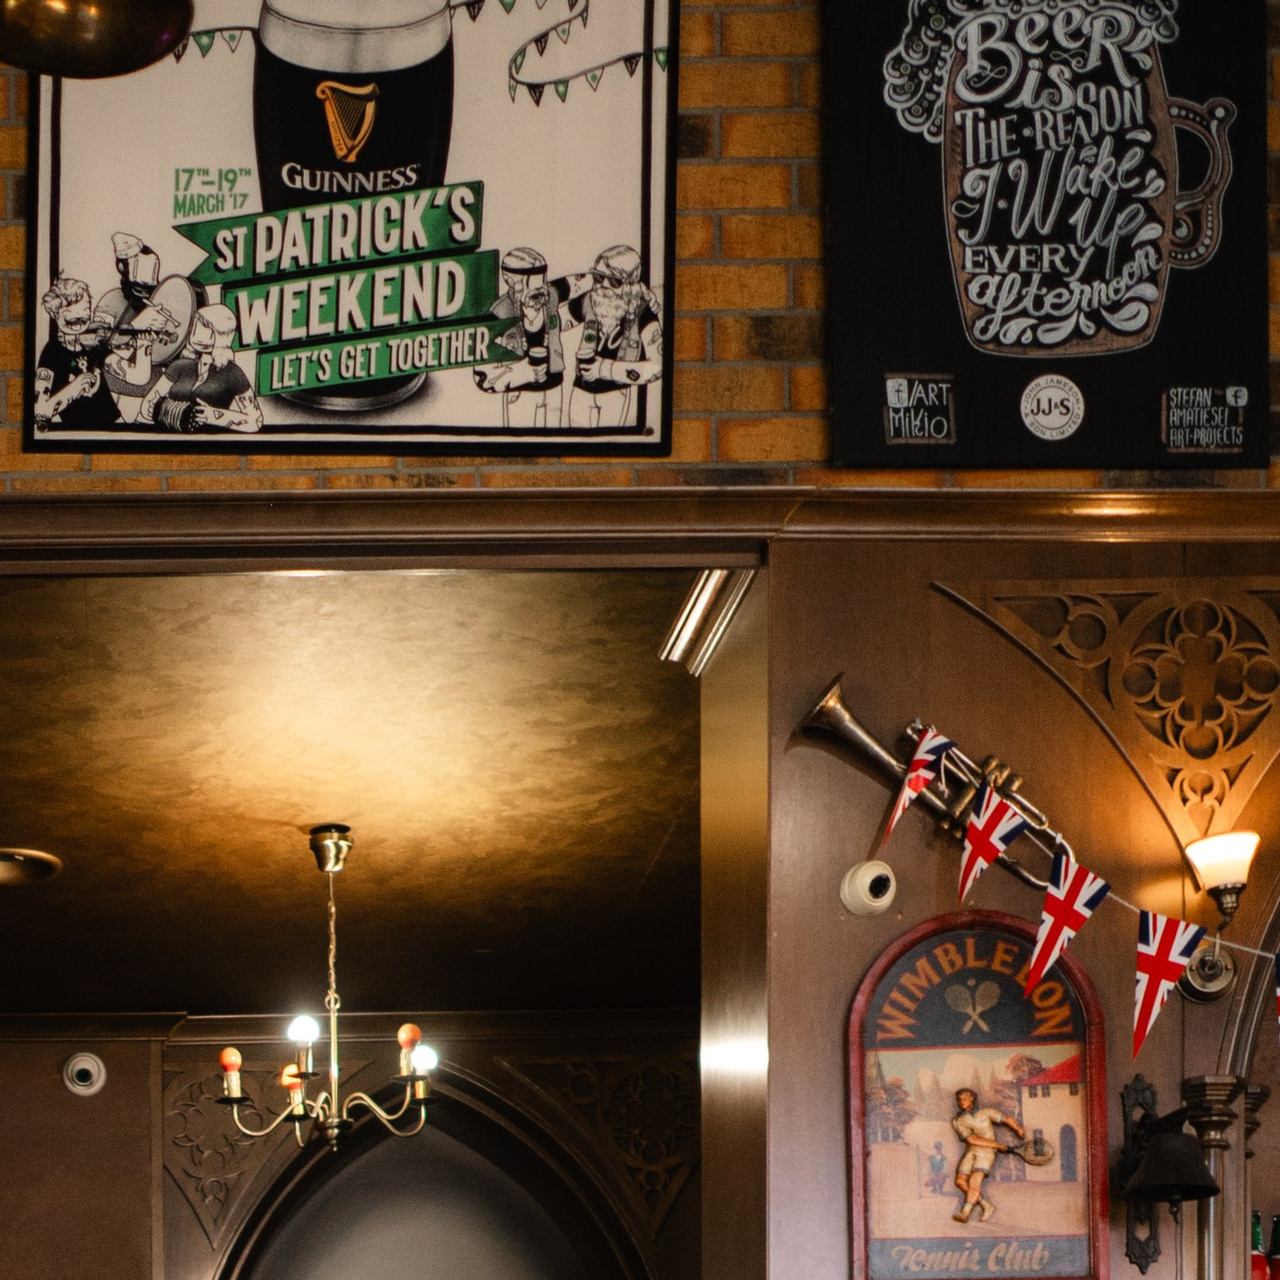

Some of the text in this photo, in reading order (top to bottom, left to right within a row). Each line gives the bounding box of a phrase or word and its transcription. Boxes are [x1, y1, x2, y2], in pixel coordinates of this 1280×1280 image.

[954, 81, 1145, 168] THE REASON
[281, 162, 418, 193] GUINNESS
[174, 194, 226, 218] MARCH
[253, 186, 476, 275] PATRICK'S
[963, 242, 1094, 282] EVERY
[234, 259, 466, 347] WEEKEND
[966, 243, 1162, 342] afternoon
[270, 326, 490, 389] LET'S GET TOGETHER
[1169, 386, 1213, 409] STEFAN
[890, 1240, 1050, 1273] Tennis Club
